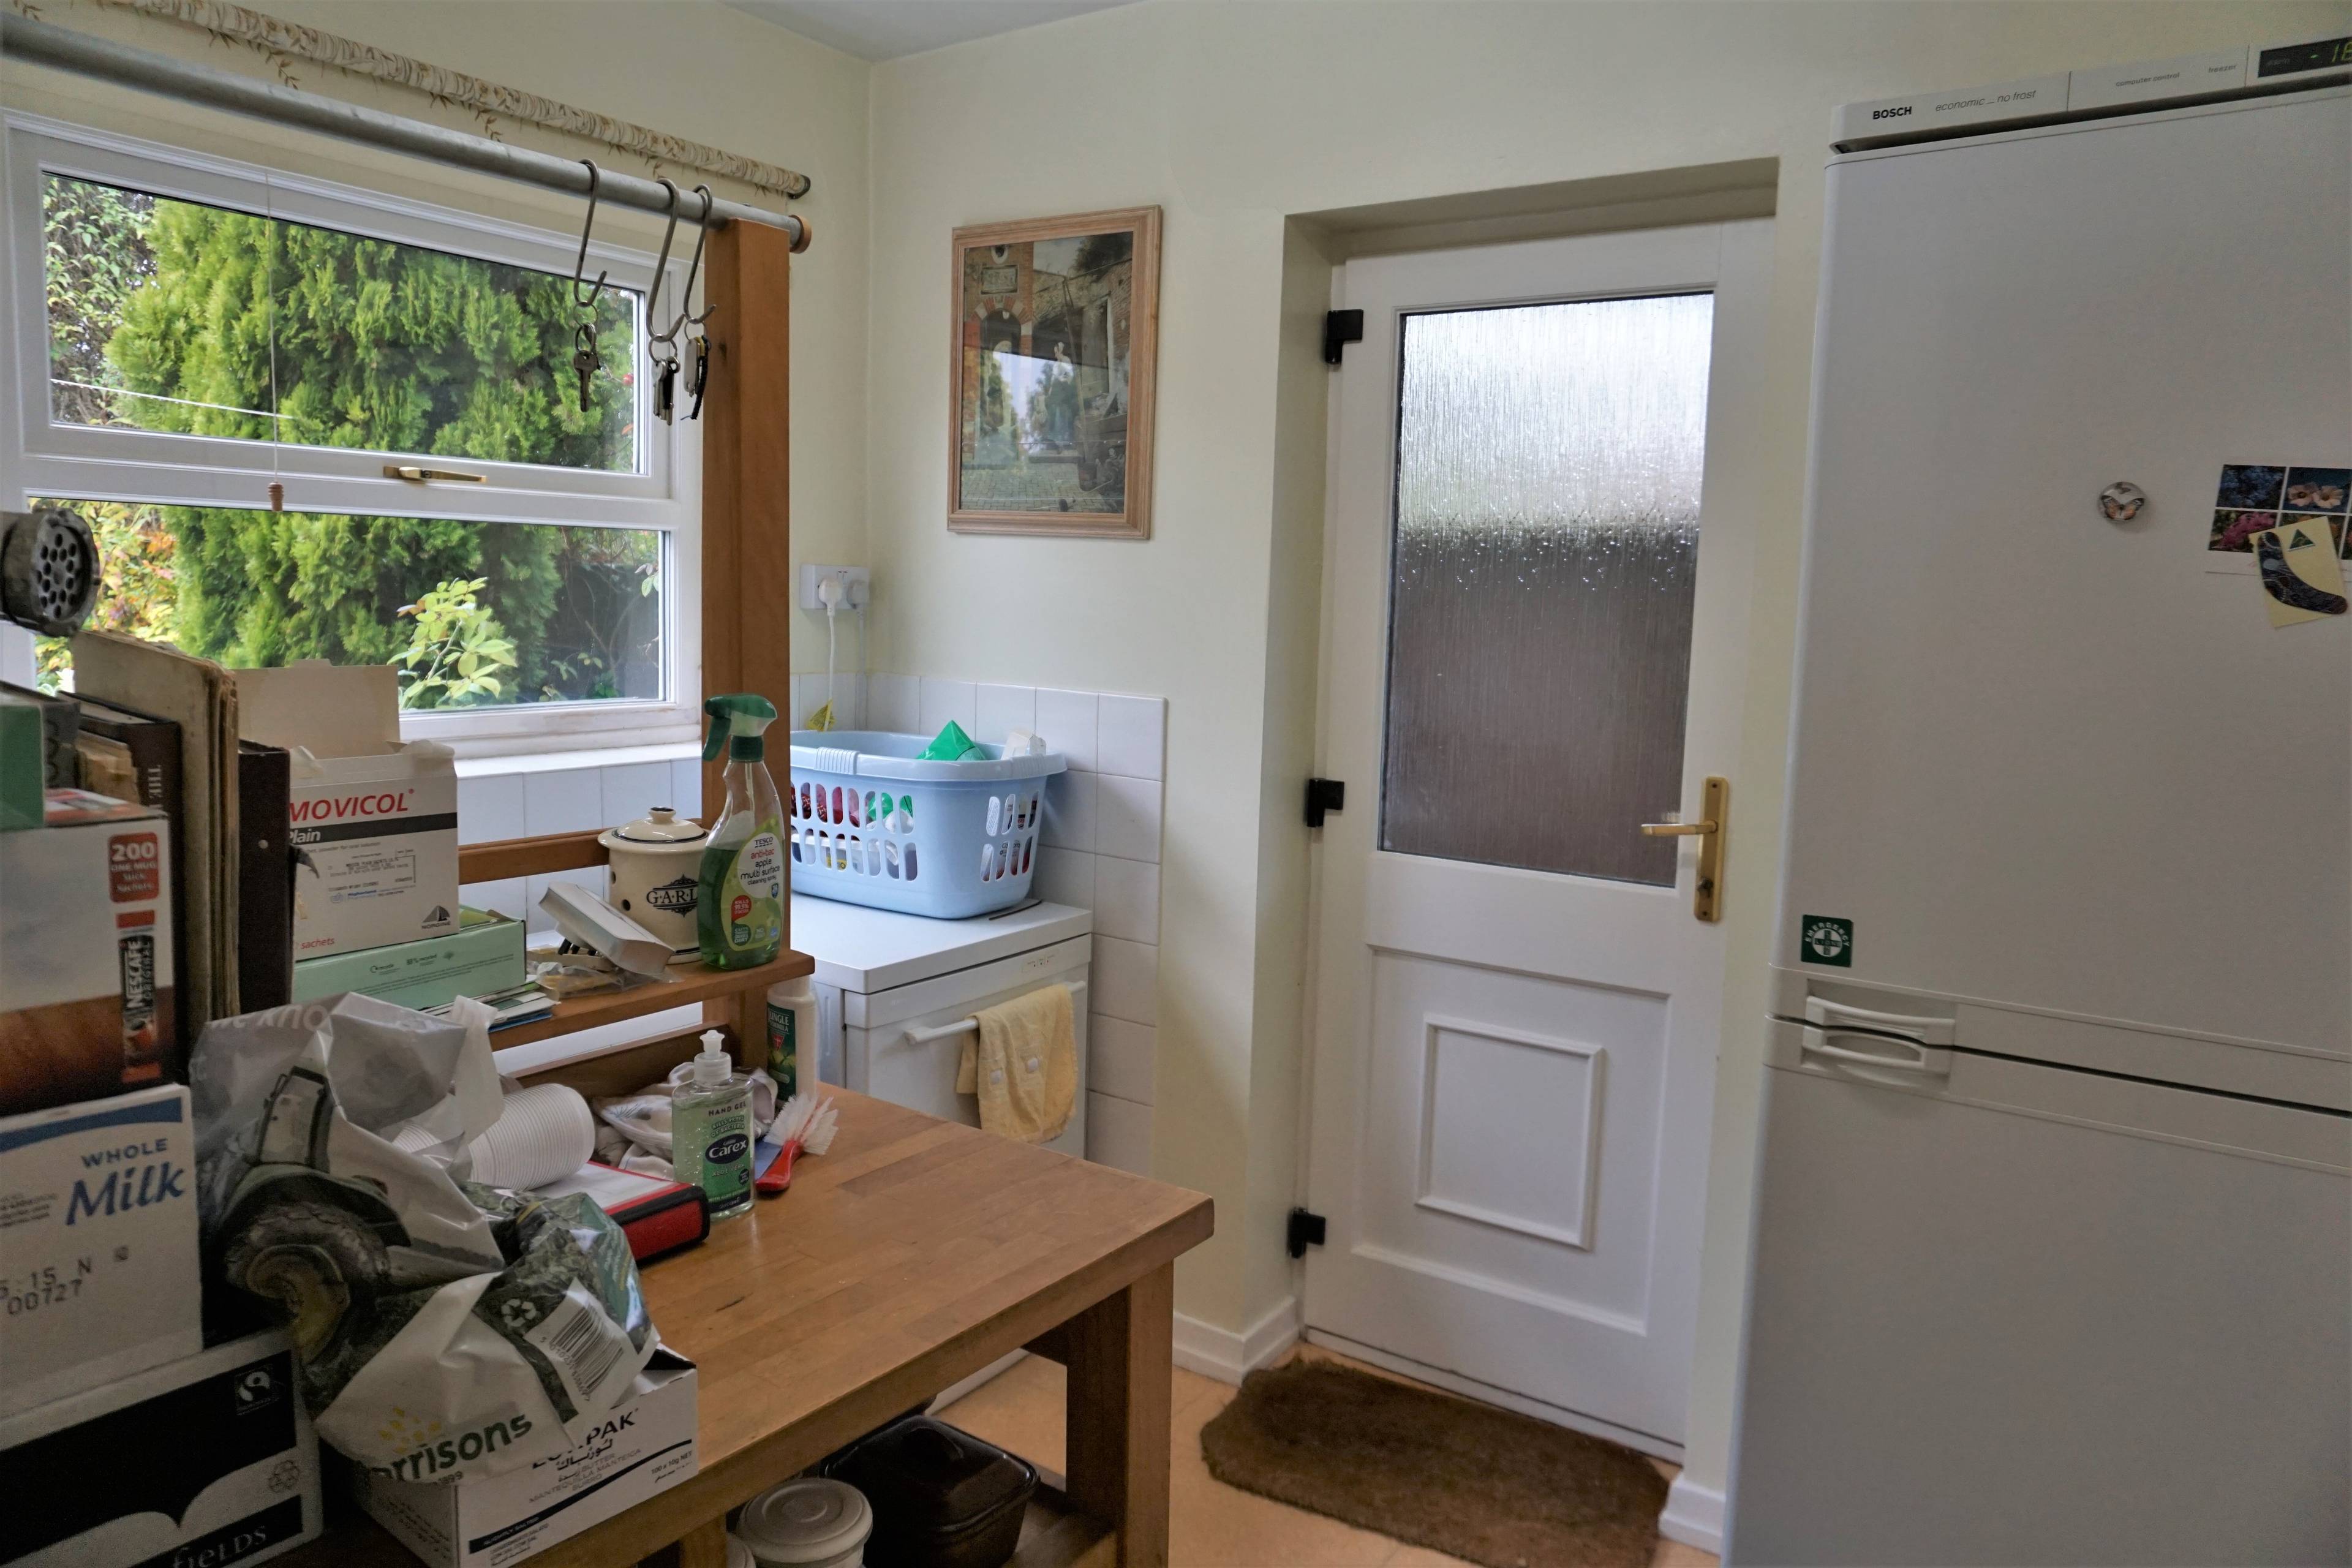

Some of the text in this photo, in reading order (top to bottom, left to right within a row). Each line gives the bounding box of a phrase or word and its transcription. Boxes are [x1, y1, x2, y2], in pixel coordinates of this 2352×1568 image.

[2207, 64, 2237, 74] freezer
[2116, 72, 2180, 87] computer control
[1935, 90, 2037, 111] economic no frost
[1872, 106, 1912, 119] BOSCH
[290, 793, 408, 822] MOVICOL
[755, 837, 773, 845] TESCO
[111, 842, 155, 862] 200
[755, 858, 772, 869] apple
[741, 865, 780, 880] multi surface
[421, 921, 451, 929] NORGINE
[1804, 922, 1850, 946] EMERGENCY
[300, 938, 334, 949] sachets
[768, 1008, 789, 1025] JUNGLE
[709, 1101, 746, 1117] HAND GEL
[81, 1138, 168, 1168] WHOLE
[709, 1140, 747, 1158] Carex
[66, 1162, 184, 1225] Milk
[581, 1453, 615, 1471] BUTTER
[652, 1465, 663, 1474] 100
[680, 1450, 692, 1462] NET
